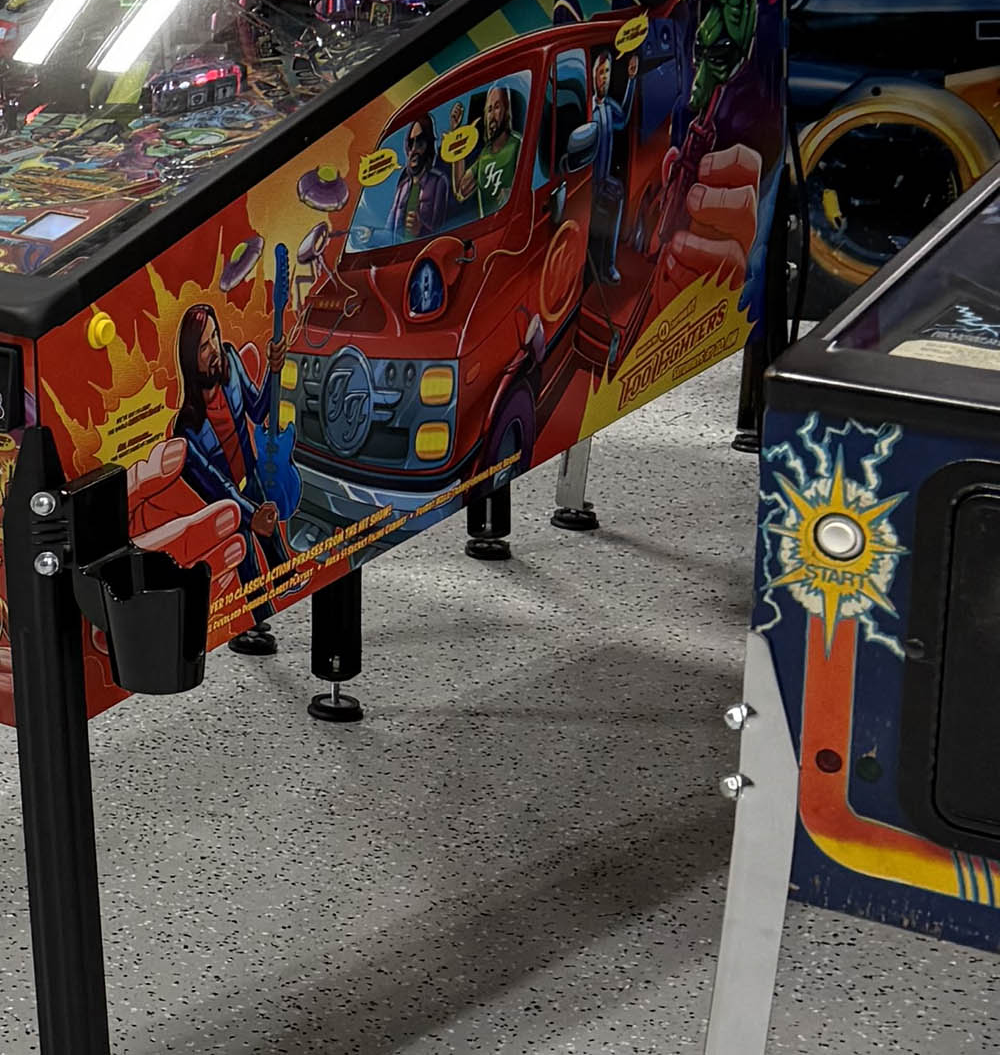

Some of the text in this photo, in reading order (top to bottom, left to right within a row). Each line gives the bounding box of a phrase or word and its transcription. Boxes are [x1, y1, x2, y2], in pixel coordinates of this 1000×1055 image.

[652, 299, 728, 383] FIGHTERS
[234, 573, 266, 599] CLASSIC
[266, 560, 291, 584] ACTION
[292, 544, 324, 569] PHRASES
[324, 529, 345, 552] FROM
[345, 523, 357, 541] THE
[357, 517, 369, 535] HIT
[805, 565, 868, 591] START
